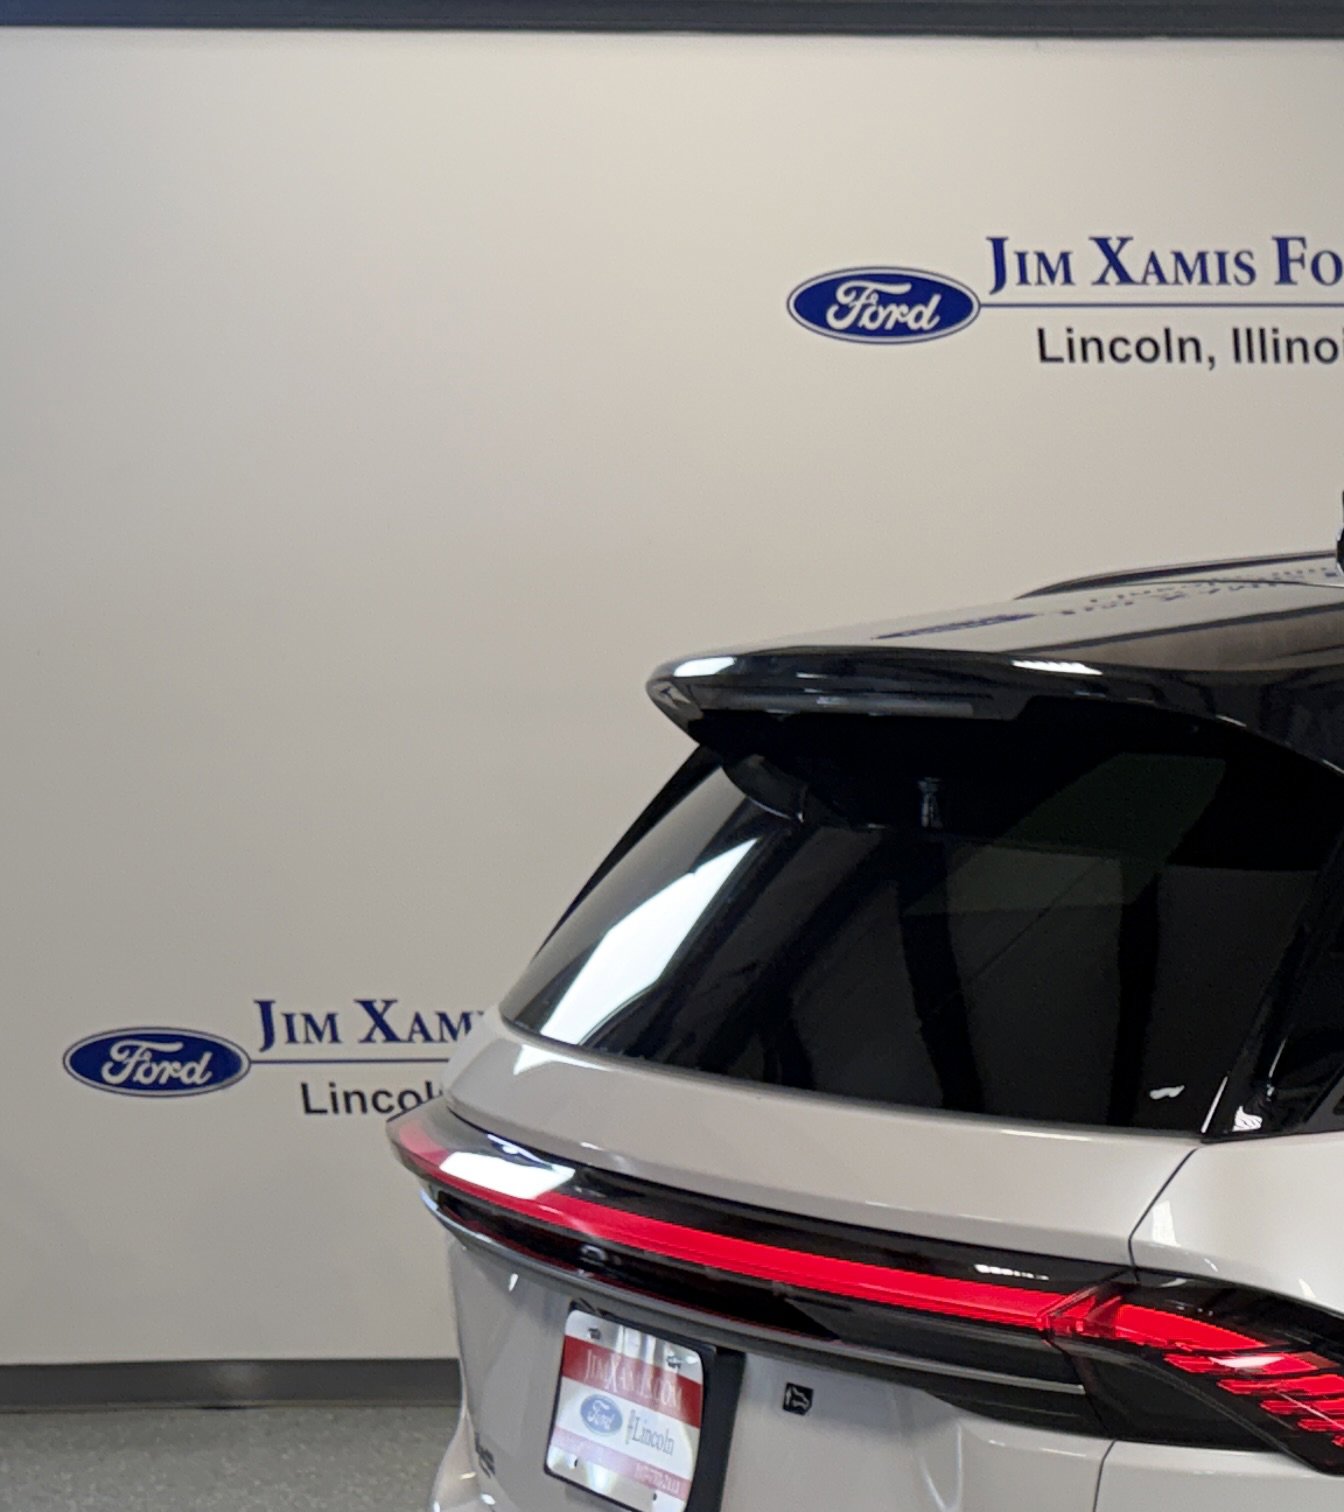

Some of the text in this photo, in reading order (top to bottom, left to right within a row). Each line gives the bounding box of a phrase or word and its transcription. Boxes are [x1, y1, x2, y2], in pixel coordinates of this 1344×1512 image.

[986, 236, 1074, 295] JIM
[1089, 236, 1256, 286] XAMIS
[826, 280, 941, 332] Ford
[1037, 327, 1216, 371] Lincoln,
[254, 999, 484, 1052] JIM XAM
[102, 1040, 213, 1086] Ford
[301, 1081, 443, 1115] Lincol
[632, 1416, 675, 1456] Lincoln
